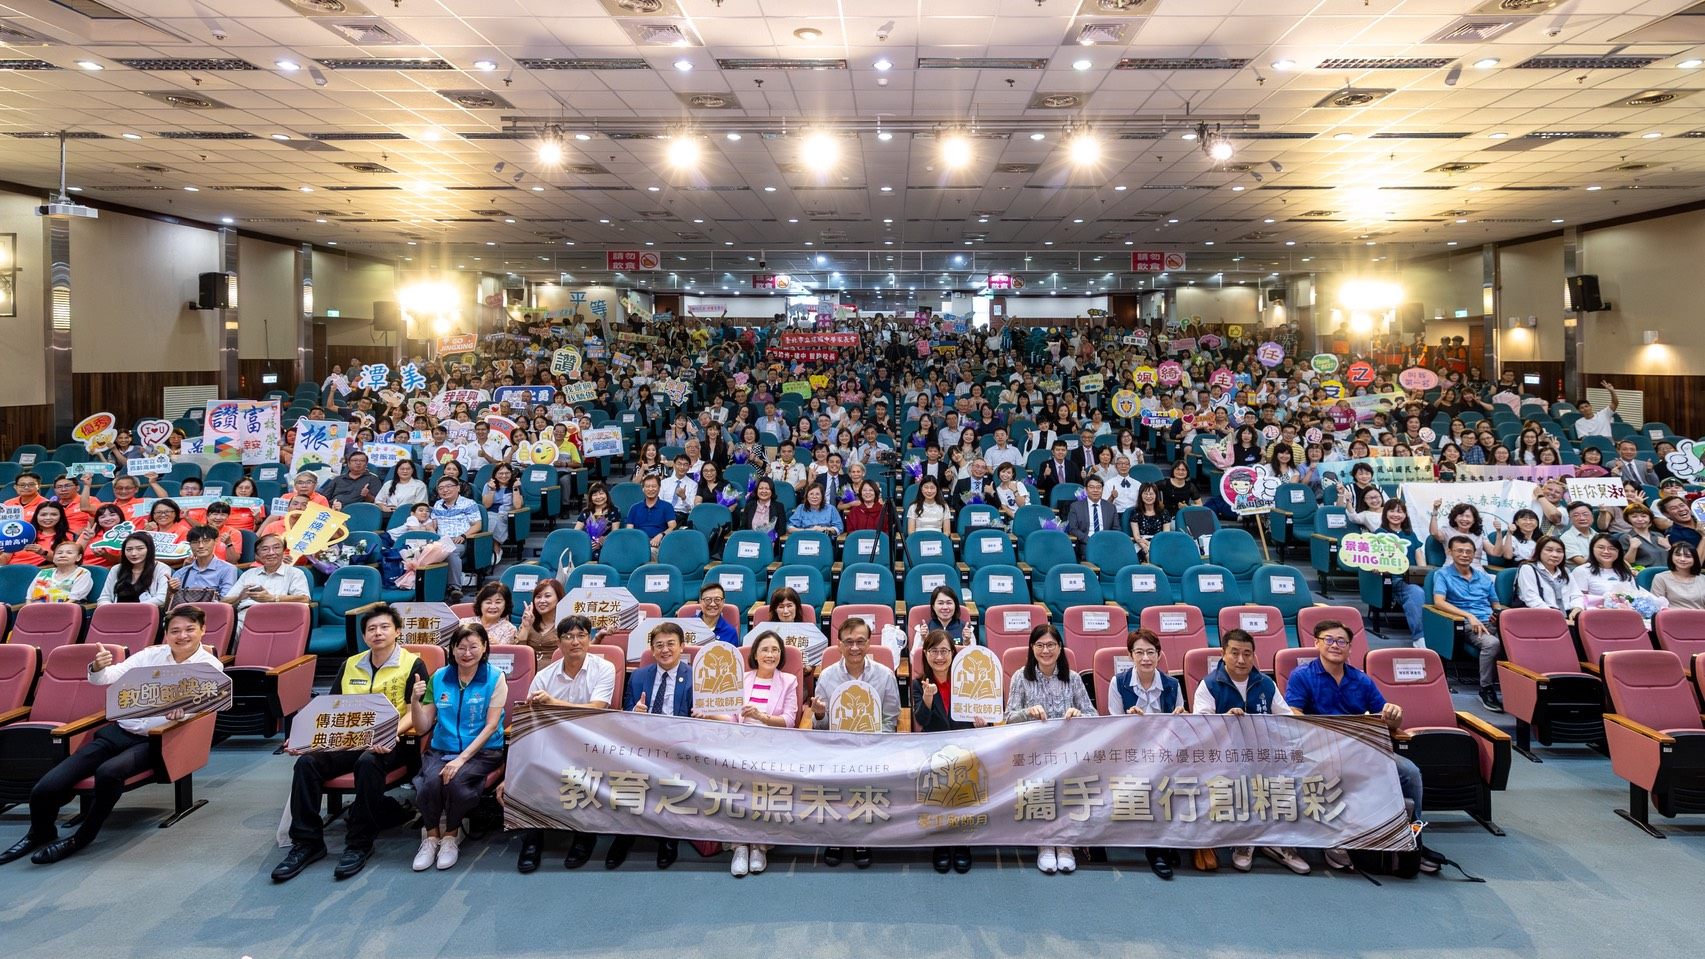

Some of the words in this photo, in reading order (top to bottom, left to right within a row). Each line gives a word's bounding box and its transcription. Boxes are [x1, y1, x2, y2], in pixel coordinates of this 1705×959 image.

[553, 352, 578, 373] 讚
[1261, 347, 1280, 361] 任
[361, 364, 388, 389] 潭
[402, 364, 426, 389] 美
[1214, 373, 1231, 388] 主
[1351, 367, 1370, 381] 之
[212, 404, 239, 430] 讚
[243, 405, 264, 433] 富
[300, 423, 330, 451] 振
[1569, 483, 1626, 499] 非你莫淑
[293, 510, 332, 553] 金牌校長
[1344, 540, 1396, 554] 景美女中
[574, 600, 622, 613] 教育之光
[400, 616, 441, 630] 手童行
[118, 678, 219, 710] 教師節快樂
[694, 696, 744, 709] 臺北敬師月
[953, 702, 1002, 715] 臺北敬師月
[315, 711, 377, 729] 傳道授業
[312, 730, 375, 749] 典範永續
[1011, 748, 1306, 768] 臺北市114學年度特殊優良教師頒獎典禮
[832, 763, 891, 775] TEACHER
[558, 764, 892, 825] 教育之光照未來
[1014, 773, 1347, 823] 攜手童行創精彩
